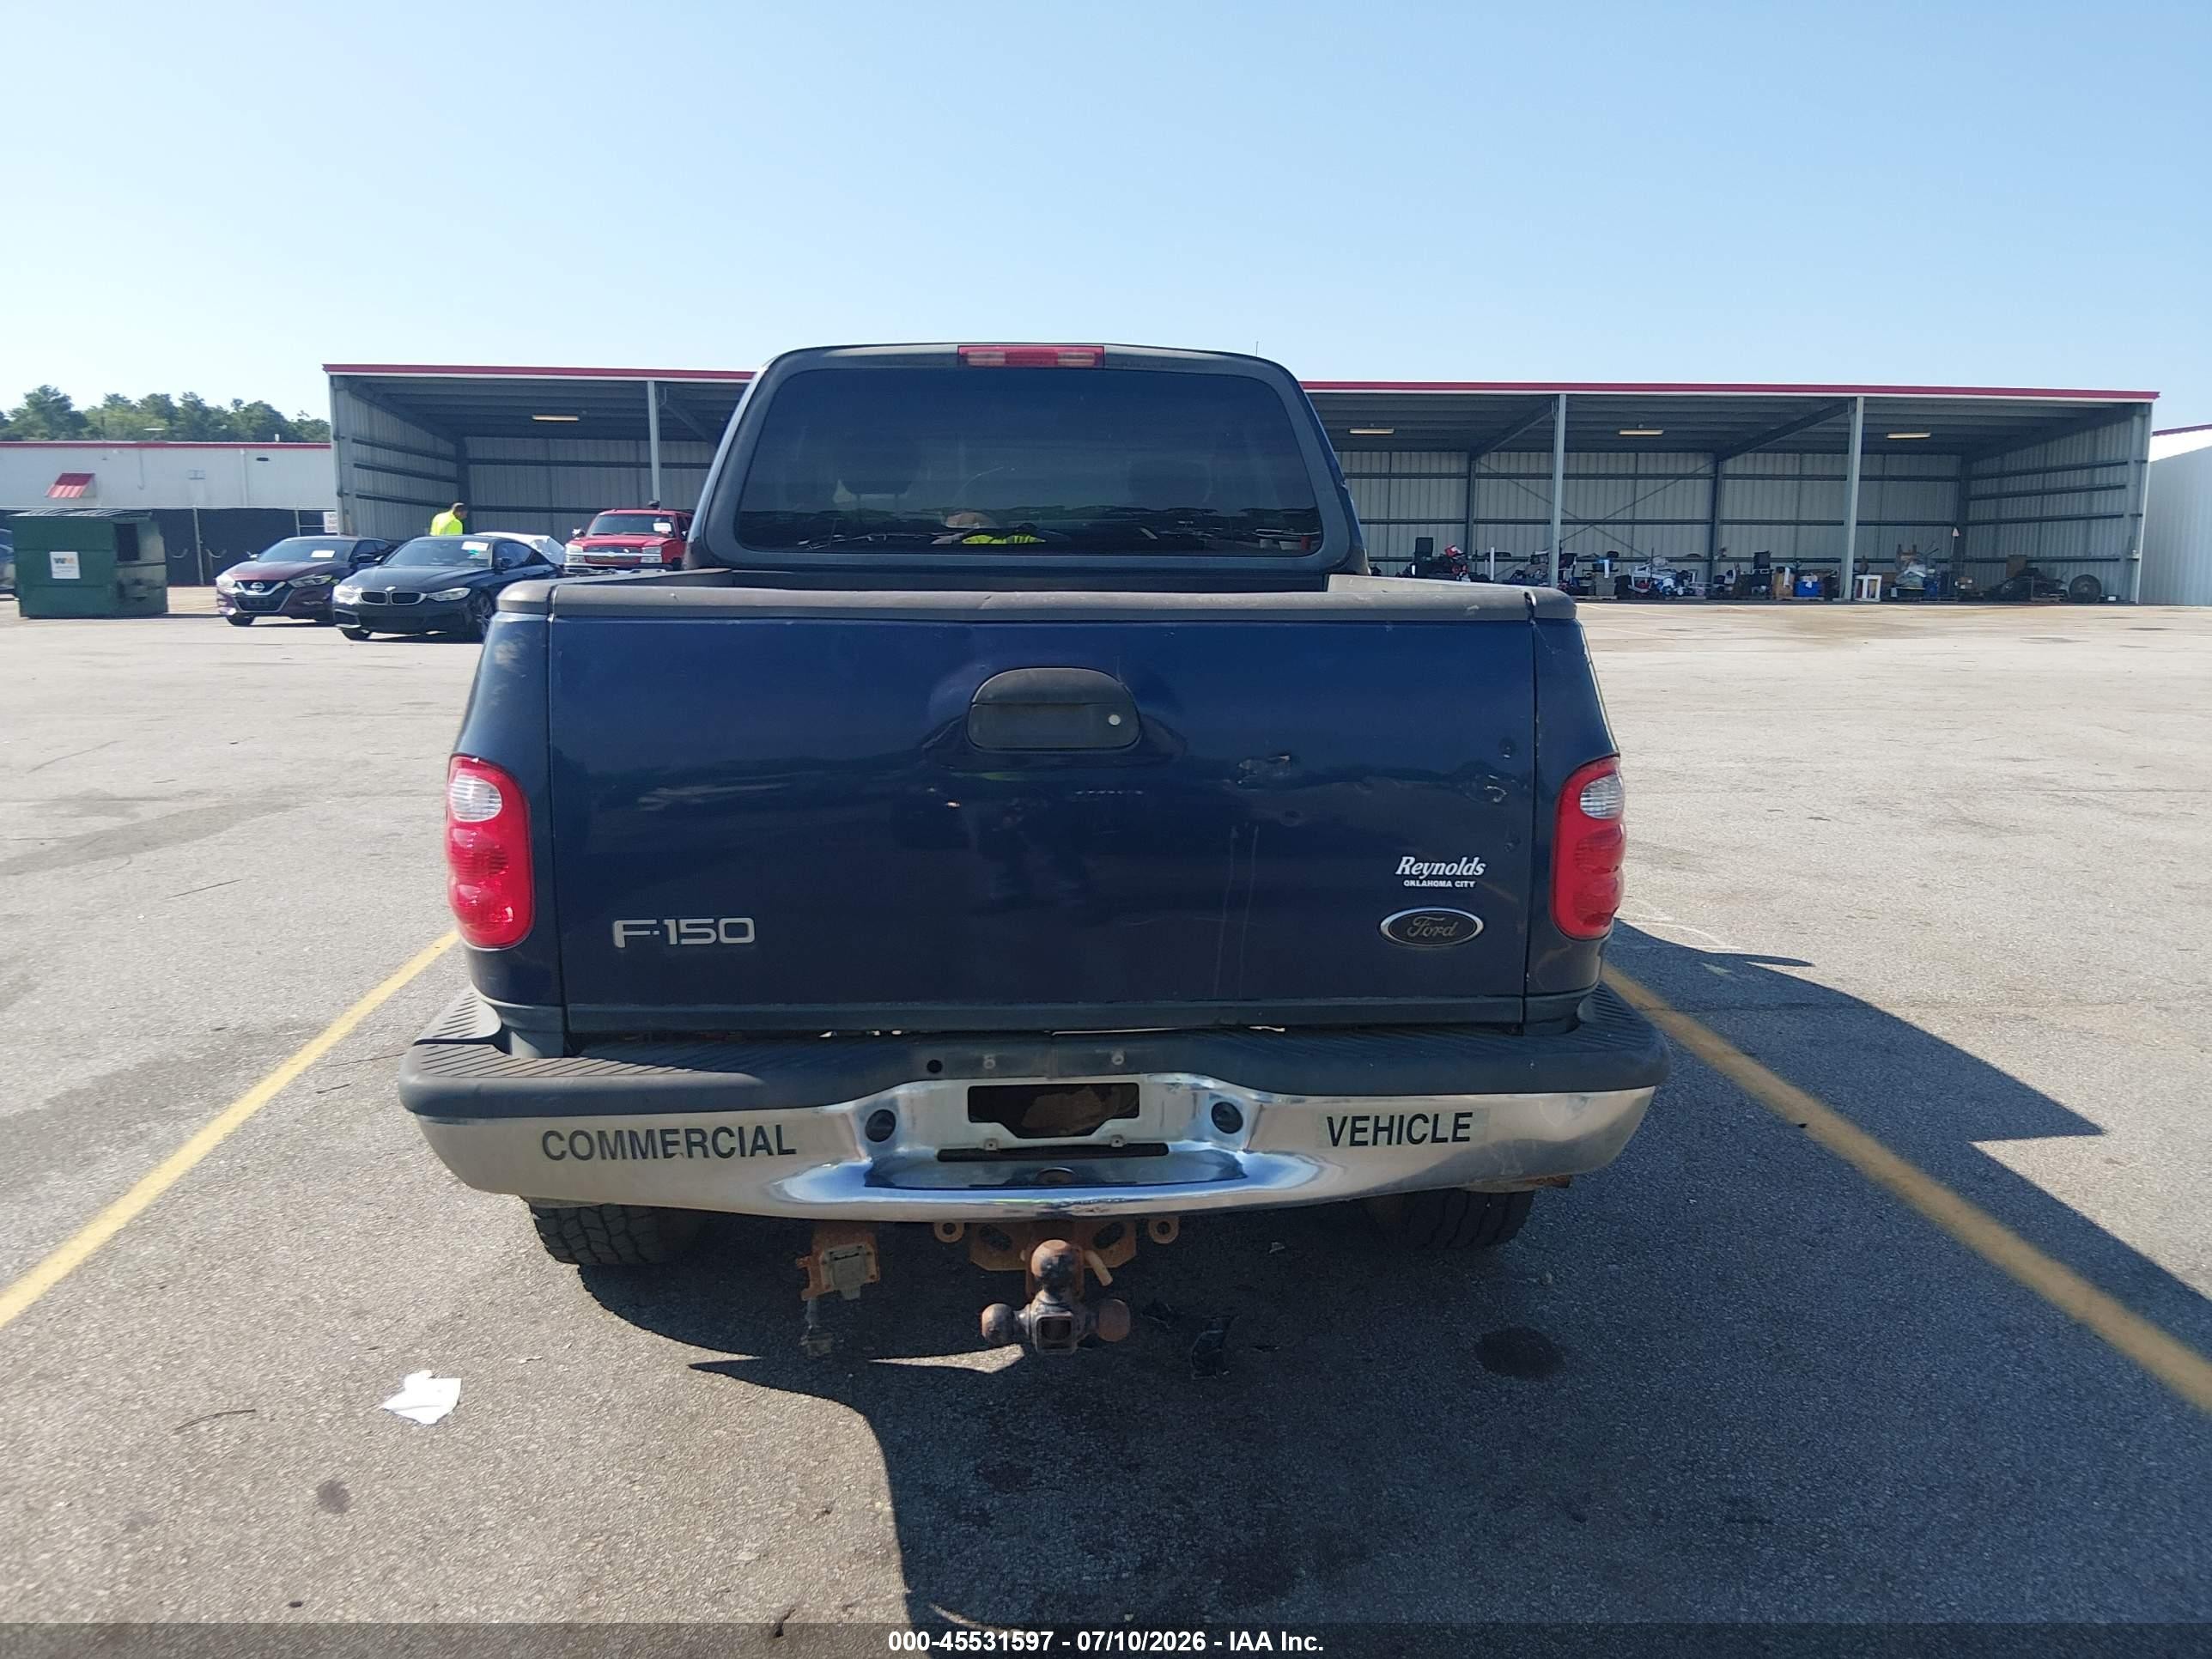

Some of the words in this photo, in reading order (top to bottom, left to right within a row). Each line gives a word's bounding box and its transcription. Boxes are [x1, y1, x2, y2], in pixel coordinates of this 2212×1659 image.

[1395, 856, 1486, 879] Reynolds
[1403, 879, 1453, 888] OKLAHOMA
[613, 917, 756, 948] F-150
[1407, 915, 1459, 938] Ford
[542, 1124, 798, 1161] COMMERCIAL
[1326, 1112, 1474, 1147] VEHICLE
